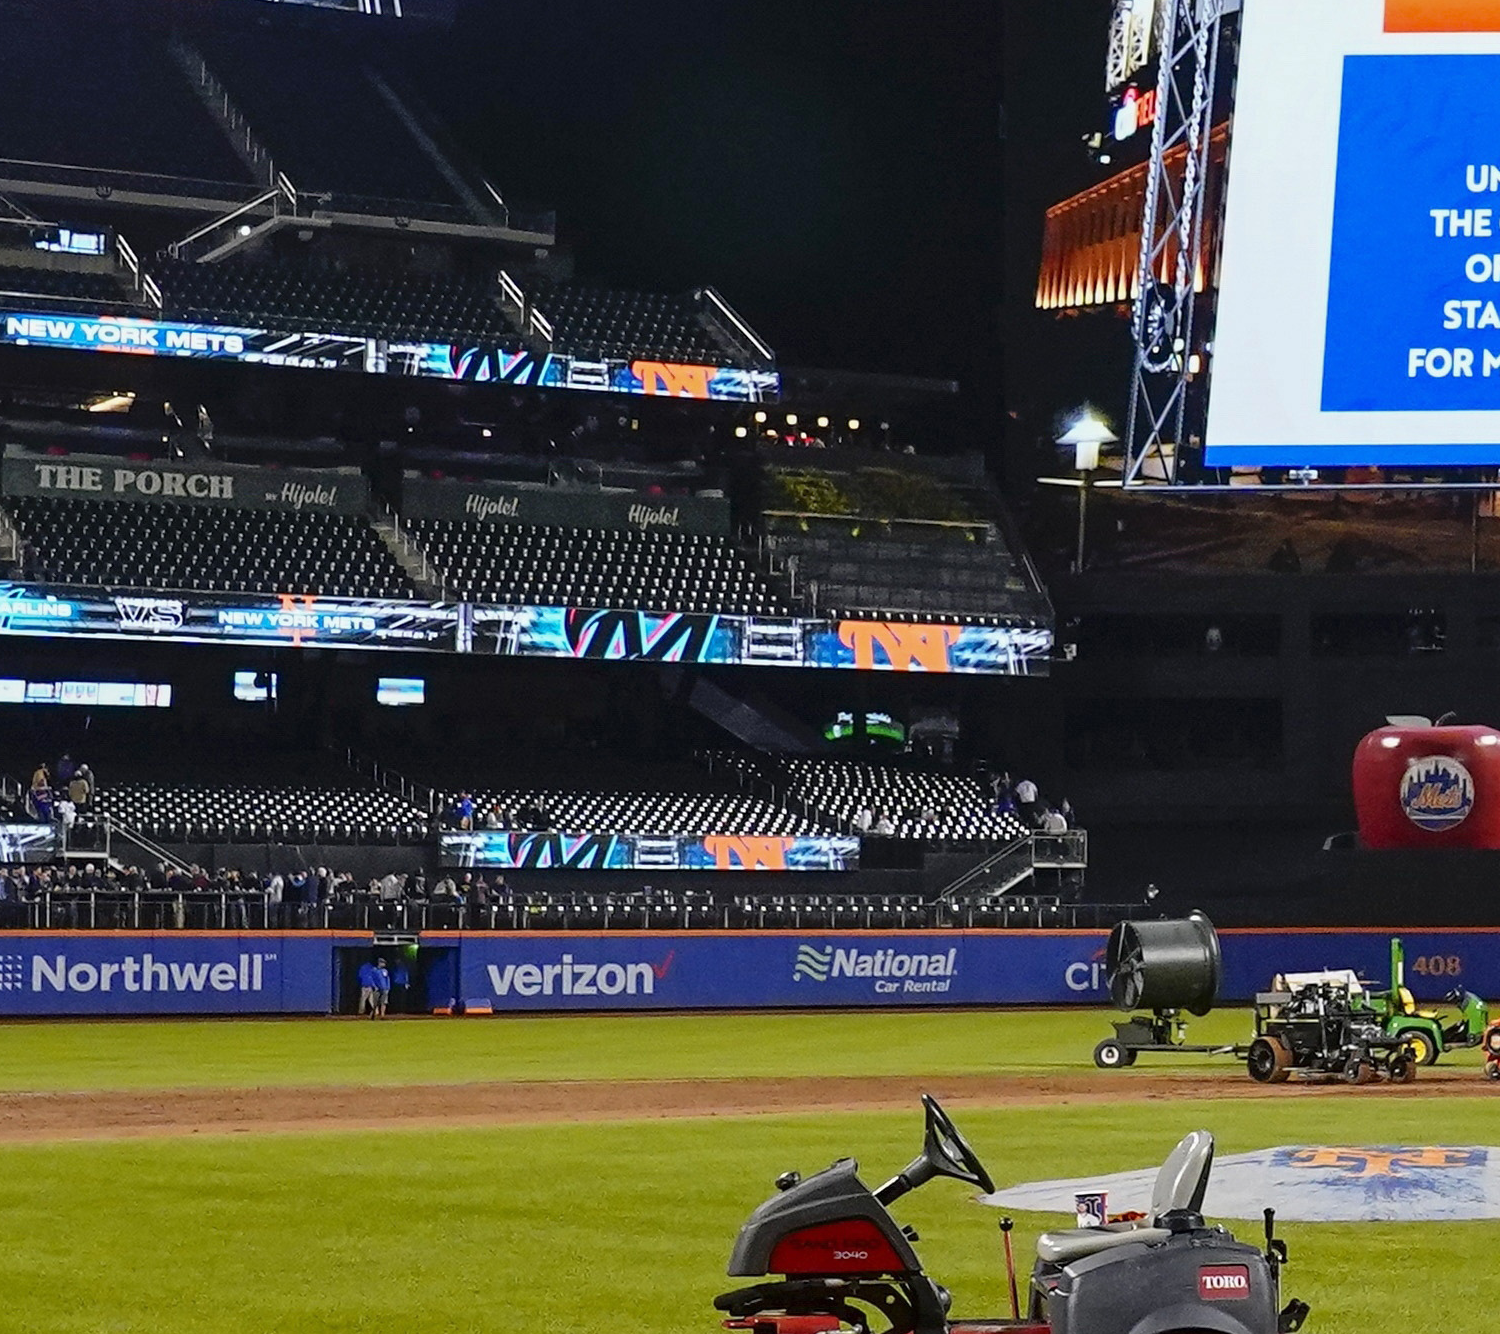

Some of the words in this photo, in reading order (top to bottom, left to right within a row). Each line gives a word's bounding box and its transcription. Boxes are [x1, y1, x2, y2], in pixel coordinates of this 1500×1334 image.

[1430, 209, 1491, 236] THE
[6, 317, 78, 340] NEW
[80, 323, 160, 347] YORK
[165, 330, 244, 353] METS
[1408, 349, 1473, 377] FOR
[35, 464, 102, 491] THE
[113, 468, 234, 500] PORCH
[219, 609, 262, 625] NEW
[265, 613, 319, 629] YORK
[323, 616, 376, 631] METS
[31, 954, 263, 992] Northwell
[487, 953, 654, 995] verizon
[1411, 955, 1463, 977] 408
[875, 980, 901, 993] Car
[903, 979, 950, 993] Rental
[833, 1250, 869, 1260] 3040
[1202, 1275, 1246, 1290] TORO
